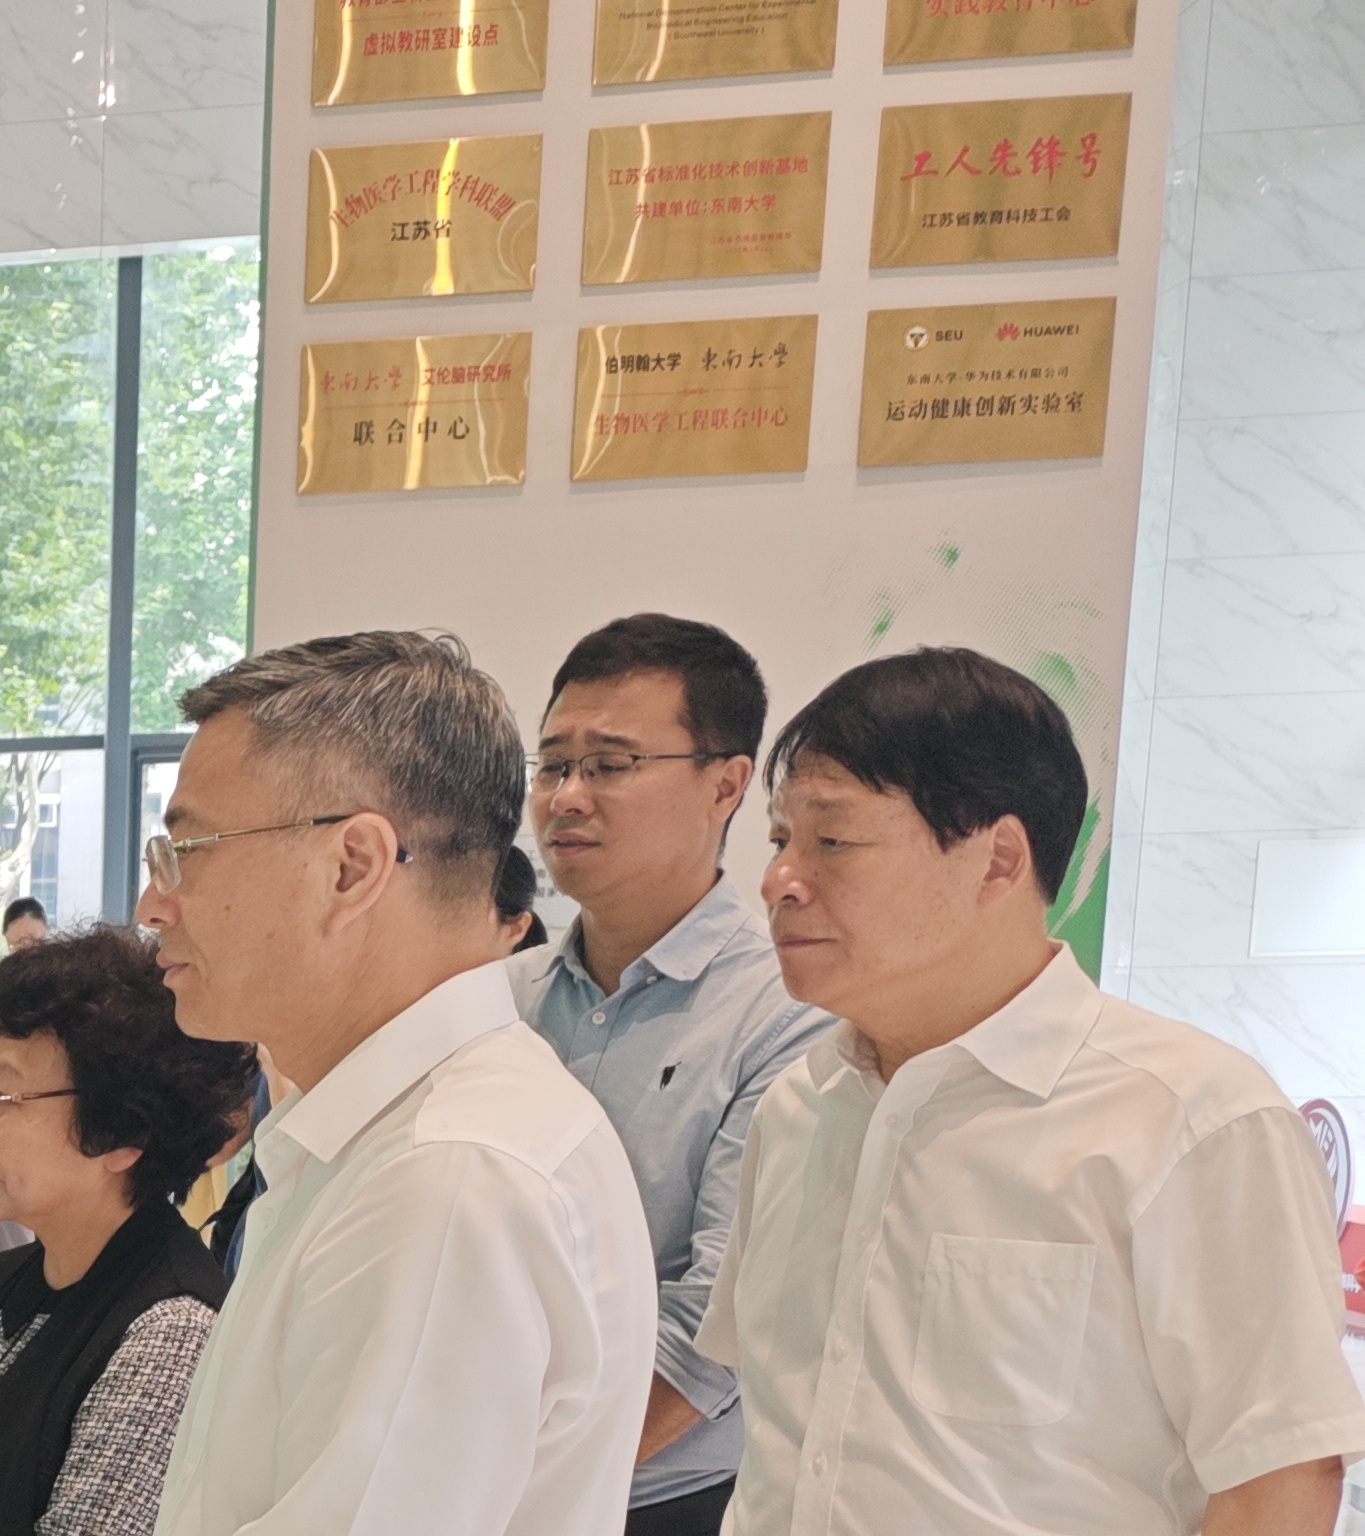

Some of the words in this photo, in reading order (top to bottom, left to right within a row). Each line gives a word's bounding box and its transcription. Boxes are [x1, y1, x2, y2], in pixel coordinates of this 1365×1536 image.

[900, 132, 1102, 184] 工人先锋号
[390, 220, 453, 243] 江苏省
[935, 330, 964, 342] SEU
[1023, 324, 1080, 337] HUAWEI
[421, 363, 512, 386] 艾伦脑研究所
[605, 352, 682, 374] 伯明翰大学
[886, 391, 1085, 422] 运动健康创新实验室
[352, 414, 470, 447] 联合中心
[594, 405, 789, 436] 生物医学工程联合中心
